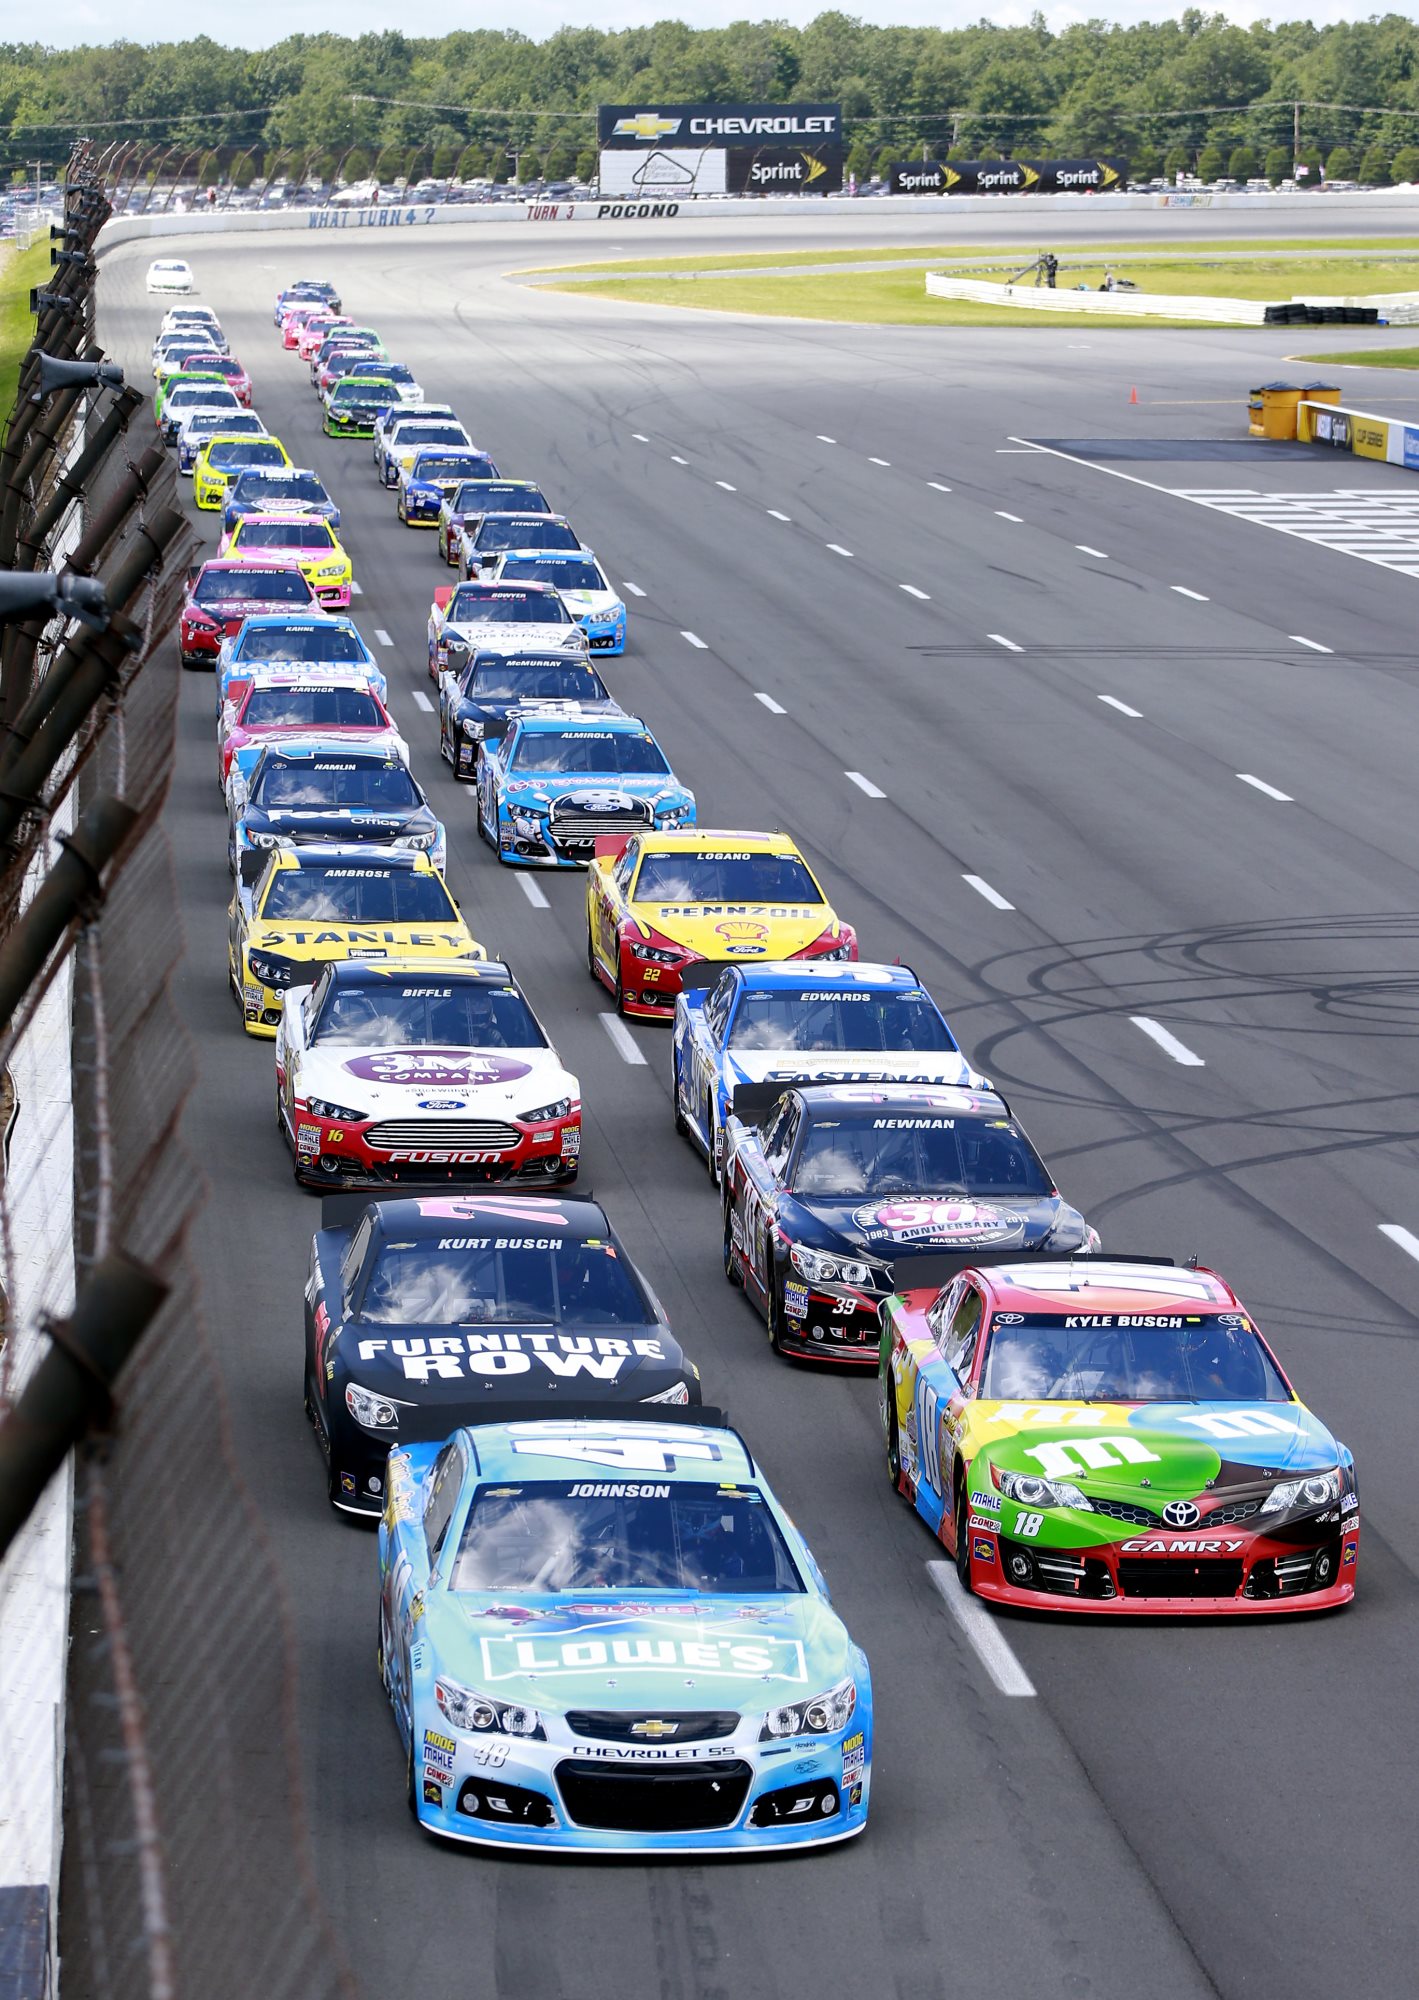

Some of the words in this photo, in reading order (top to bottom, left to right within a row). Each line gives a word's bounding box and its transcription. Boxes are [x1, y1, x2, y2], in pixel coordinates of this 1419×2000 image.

[690, 117, 835, 134] CHEVROLET
[752, 163, 802, 184] Sprint
[899, 172, 940, 190] Sprint
[977, 171, 1019, 189] Sprint
[1056, 169, 1098, 189] Sprint
[309, 211, 349, 228] WHAT
[357, 210, 400, 227] TURN
[405, 209, 416, 225] 4
[425, 208, 435, 224] ?
[527, 205, 557, 220] TURN
[566, 205, 574, 220] 3
[597, 203, 679, 219] POCONO
[187, 631, 194, 640] 2
[267, 808, 376, 823] FedE
[350, 817, 400, 827] Office
[522, 823, 536, 835] 43
[696, 853, 751, 861] LOGANO
[324, 869, 391, 879] AMBROSE
[660, 906, 816, 919] PENNZOIL
[261, 930, 465, 948] STANLEY
[643, 967, 661, 982] 22
[272, 988, 285, 1001] 9
[402, 988, 452, 998] BIFFLE
[800, 992, 871, 1002] EDWARDS
[369, 1053, 500, 1073] 3M
[378, 1071, 501, 1082] COMPANY
[299, 1123, 322, 1133] MOOG
[873, 1118, 955, 1129] NEWMAN
[298, 1132, 319, 1144] MAHLE
[327, 1129, 344, 1142] 16
[388, 1152, 501, 1163] FUSION
[885, 1203, 978, 1227] 30
[1006, 1215, 1030, 1224] 2013
[864, 1229, 889, 1241] 1983
[900, 1221, 999, 1239] ANNIVERSARY
[438, 1238, 491, 1249] KURT
[494, 1238, 563, 1250] BUSCH
[929, 1236, 958, 1244] MADE
[970, 1235, 986, 1243] THE
[785, 1280, 809, 1295] MOOG
[786, 1291, 808, 1306] MAHLE
[832, 1297, 858, 1315] 39
[1065, 1315, 1112, 1328] KYLE
[1117, 1315, 1183, 1329] BUSCH
[358, 1333, 666, 1361] FURNITURE
[400, 1350, 627, 1379] ROW
[985, 1403, 1108, 1426] m
[1175, 1410, 1312, 1439] m
[1023, 1436, 1163, 1480] m
[568, 1483, 671, 1499] JOHNSON
[971, 1491, 1002, 1510] MAHLE
[970, 1516, 994, 1528] COMP
[1013, 1511, 1044, 1537] 18
[1119, 1539, 1244, 1554] CAMRY
[591, 1606, 681, 1614] PLANES
[515, 1640, 774, 1672] LOWE'S
[425, 1730, 455, 1752] MOOG
[843, 1732, 864, 1752] MOOG
[424, 1746, 453, 1770] MAHLE
[474, 1741, 511, 1768] 48
[572, 1746, 704, 1758] CHEVROLET
[708, 1746, 736, 1756] SS
[844, 1748, 864, 1770] MAHLE
[426, 1766, 448, 1781] COMP
